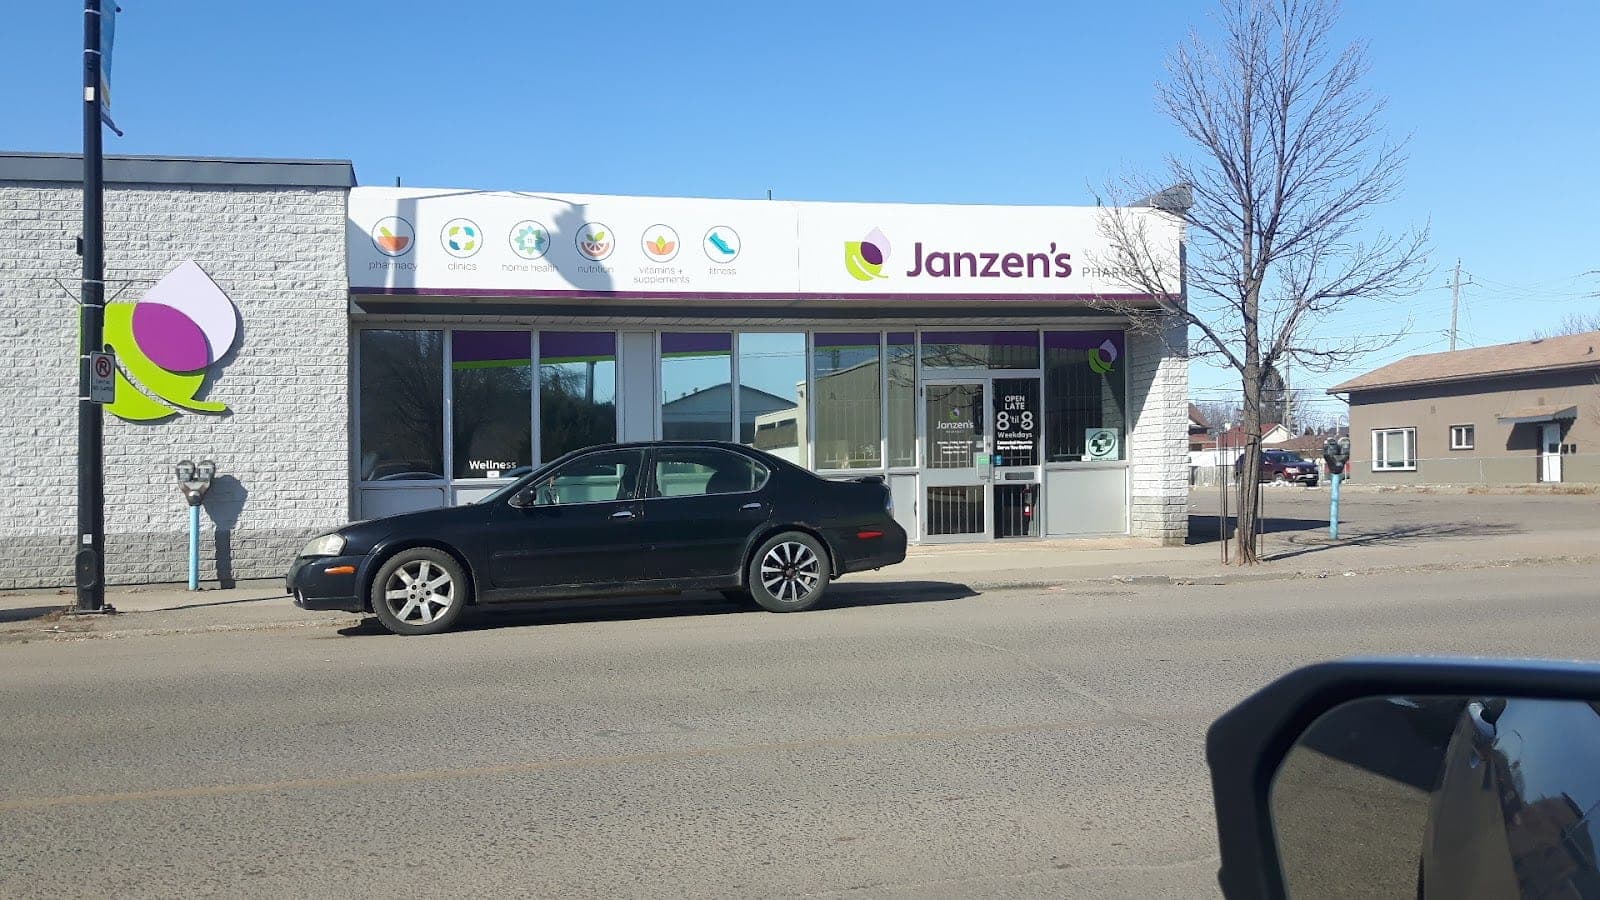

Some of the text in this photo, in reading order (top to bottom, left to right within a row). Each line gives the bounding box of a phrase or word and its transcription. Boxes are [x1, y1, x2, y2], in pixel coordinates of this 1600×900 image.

[906, 241, 1073, 278] Janzen's
[368, 260, 418, 272] pharmacy
[447, 261, 478, 271] clinics
[501, 262, 560, 273] home health
[577, 264, 614, 274] nutrition
[639, 265, 676, 275] vitamins
[633, 275, 690, 286] supplements
[1004, 402, 1025, 410] LATE
[936, 420, 974, 430] Janzen's
[996, 411, 1010, 431] 8
[1020, 411, 1034, 431] 8
[997, 431, 1033, 440] Weekdays
[469, 459, 517, 470] Wellness
